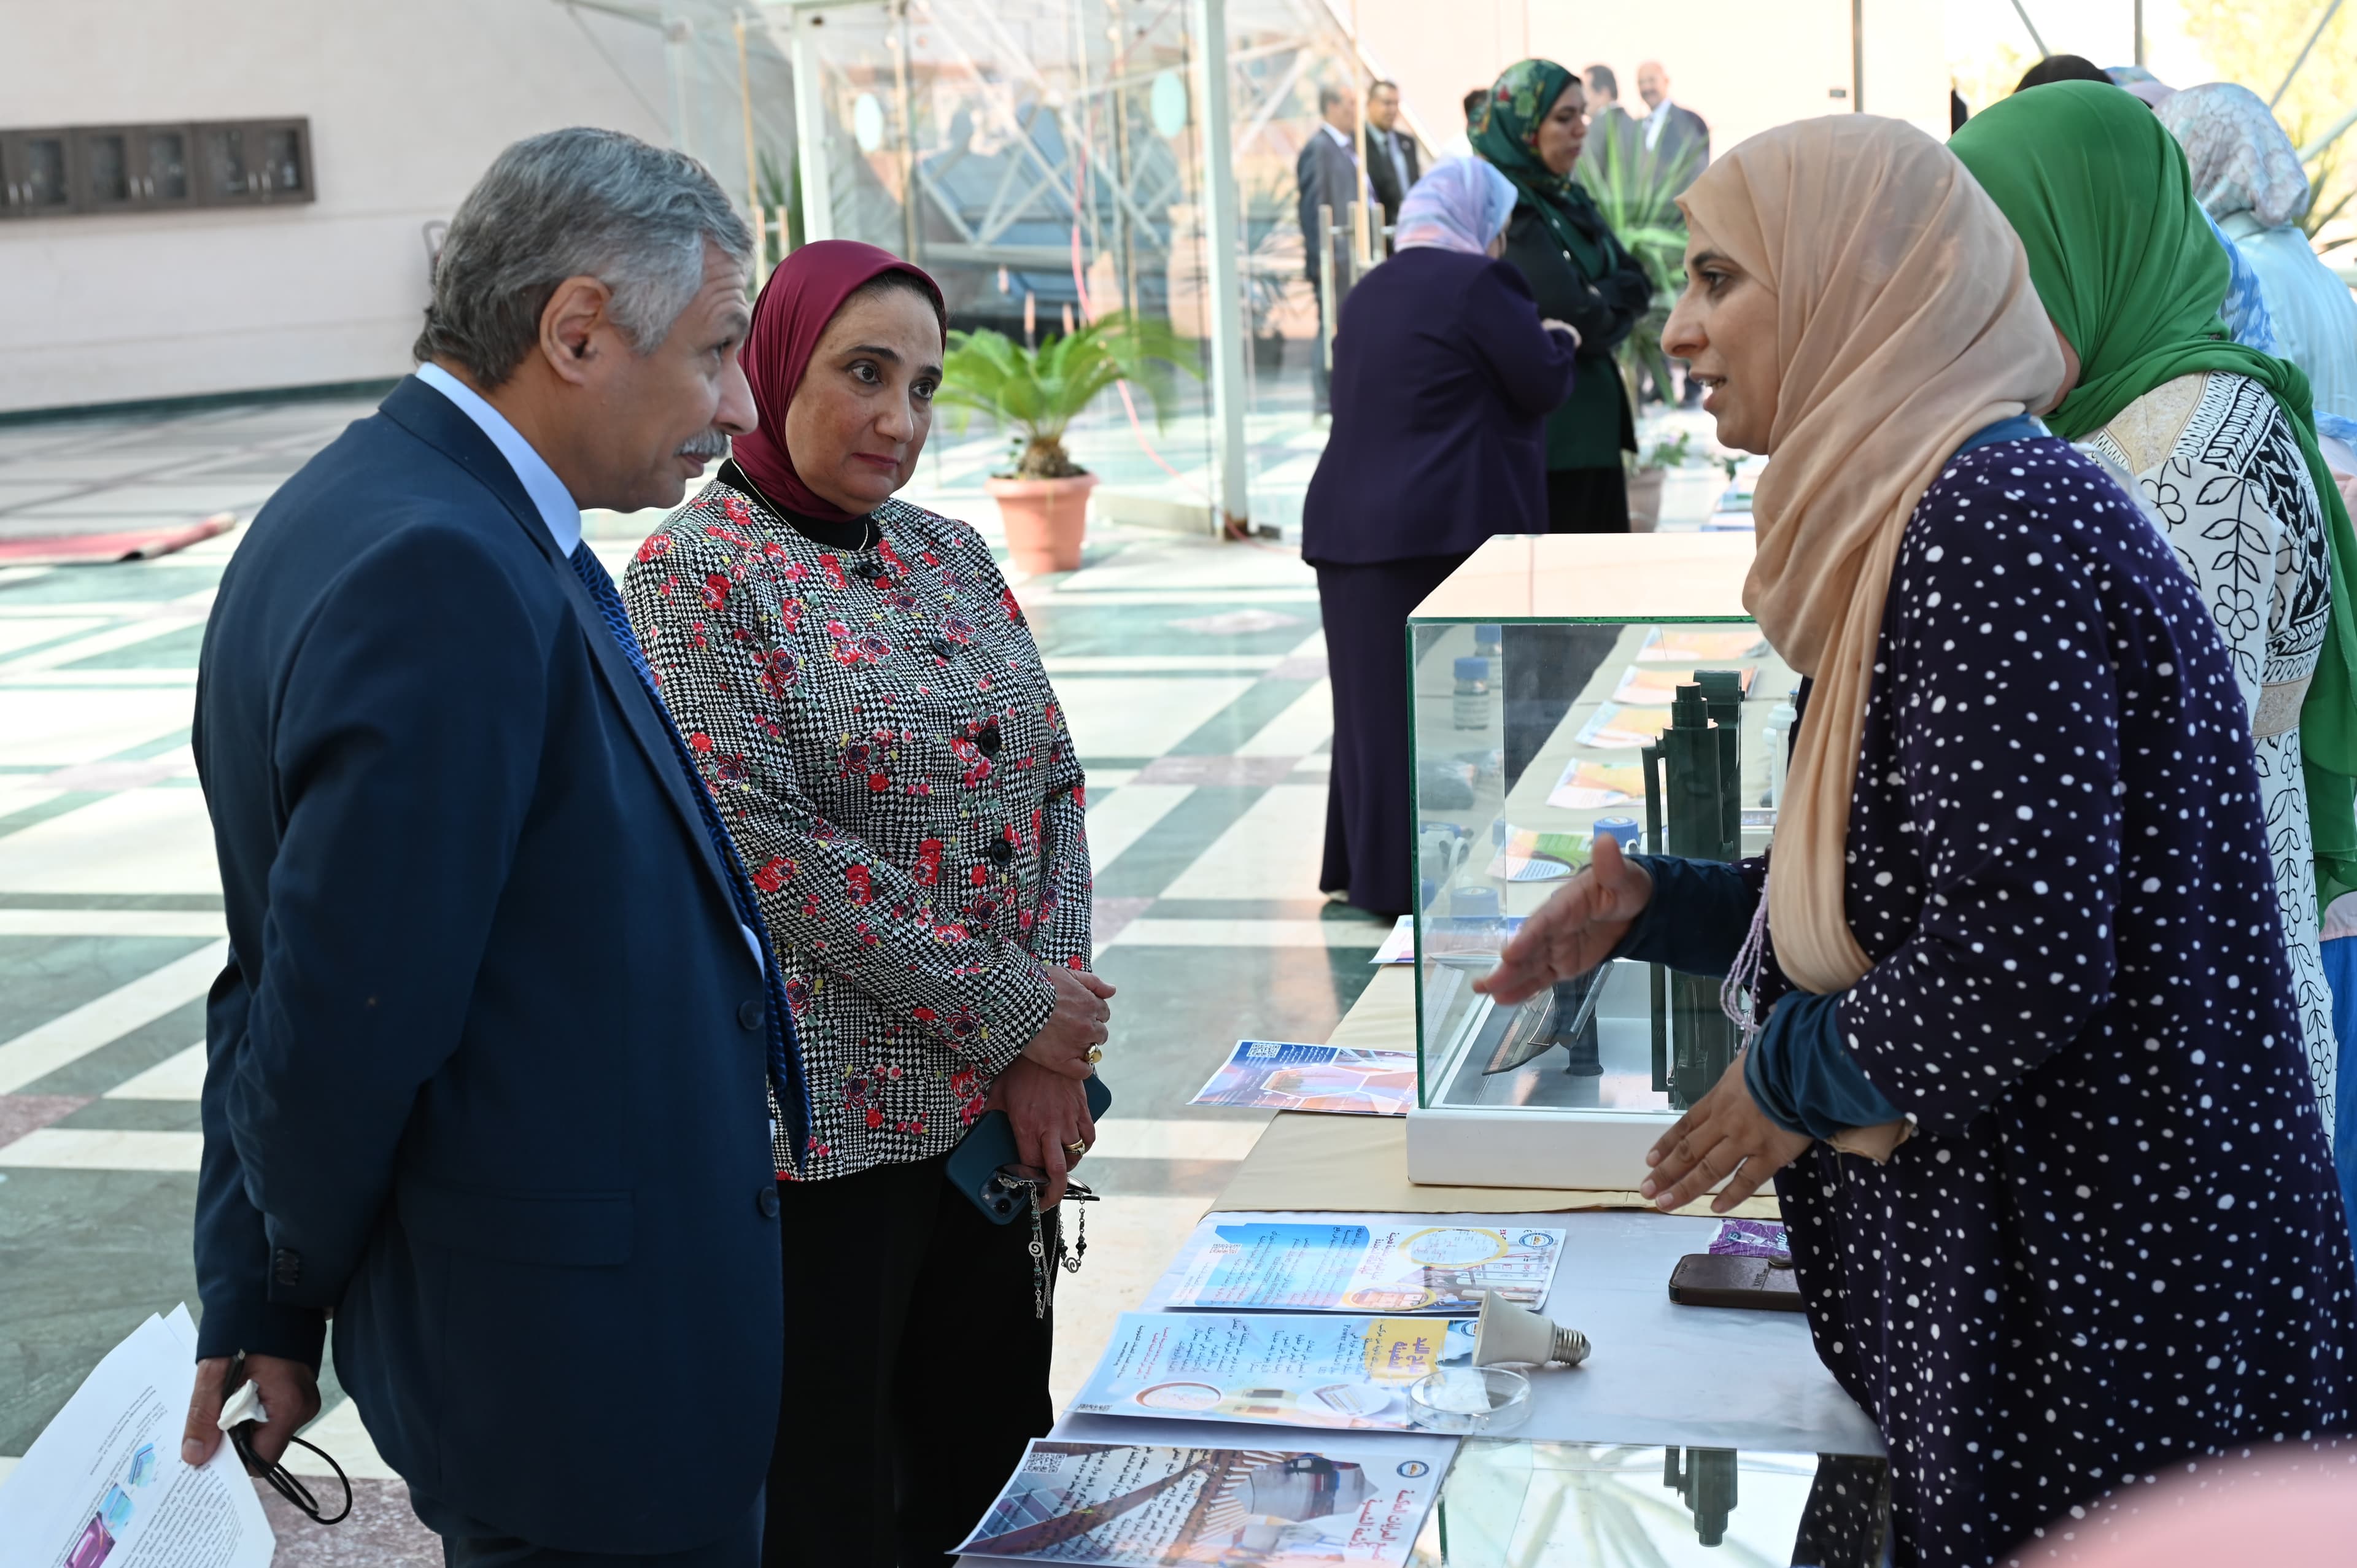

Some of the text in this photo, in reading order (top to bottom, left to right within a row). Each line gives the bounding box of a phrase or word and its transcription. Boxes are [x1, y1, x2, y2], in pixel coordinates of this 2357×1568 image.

[1383, 1232, 1402, 1245] هجينة
[1237, 1332, 1250, 1346] مختلفة
[1339, 1324, 1352, 1341] Power
[1411, 1336, 1431, 1354] الليد
[1317, 1366, 1327, 1375] LED
[160, 1474, 183, 1508] sustainability
[176, 1472, 193, 1494] avoiding
[184, 1472, 202, 1496] problem
[186, 1475, 209, 1506] inexpensive
[203, 1491, 215, 1508] water
[146, 1513, 158, 1529] water
[153, 1506, 171, 1532] problems
[157, 1475, 220, 1566] economically competitive compared
[161, 1503, 182, 1532] freshwater
[189, 1508, 204, 1529] surface
[1351, 1499, 1385, 1527] الشمسية
[186, 1519, 206, 1546] prototype
[1357, 1489, 1417, 1562] تصنيع المرايات العاكسة
[131, 1528, 149, 1554] resources
[177, 1529, 191, 1547] thanks
